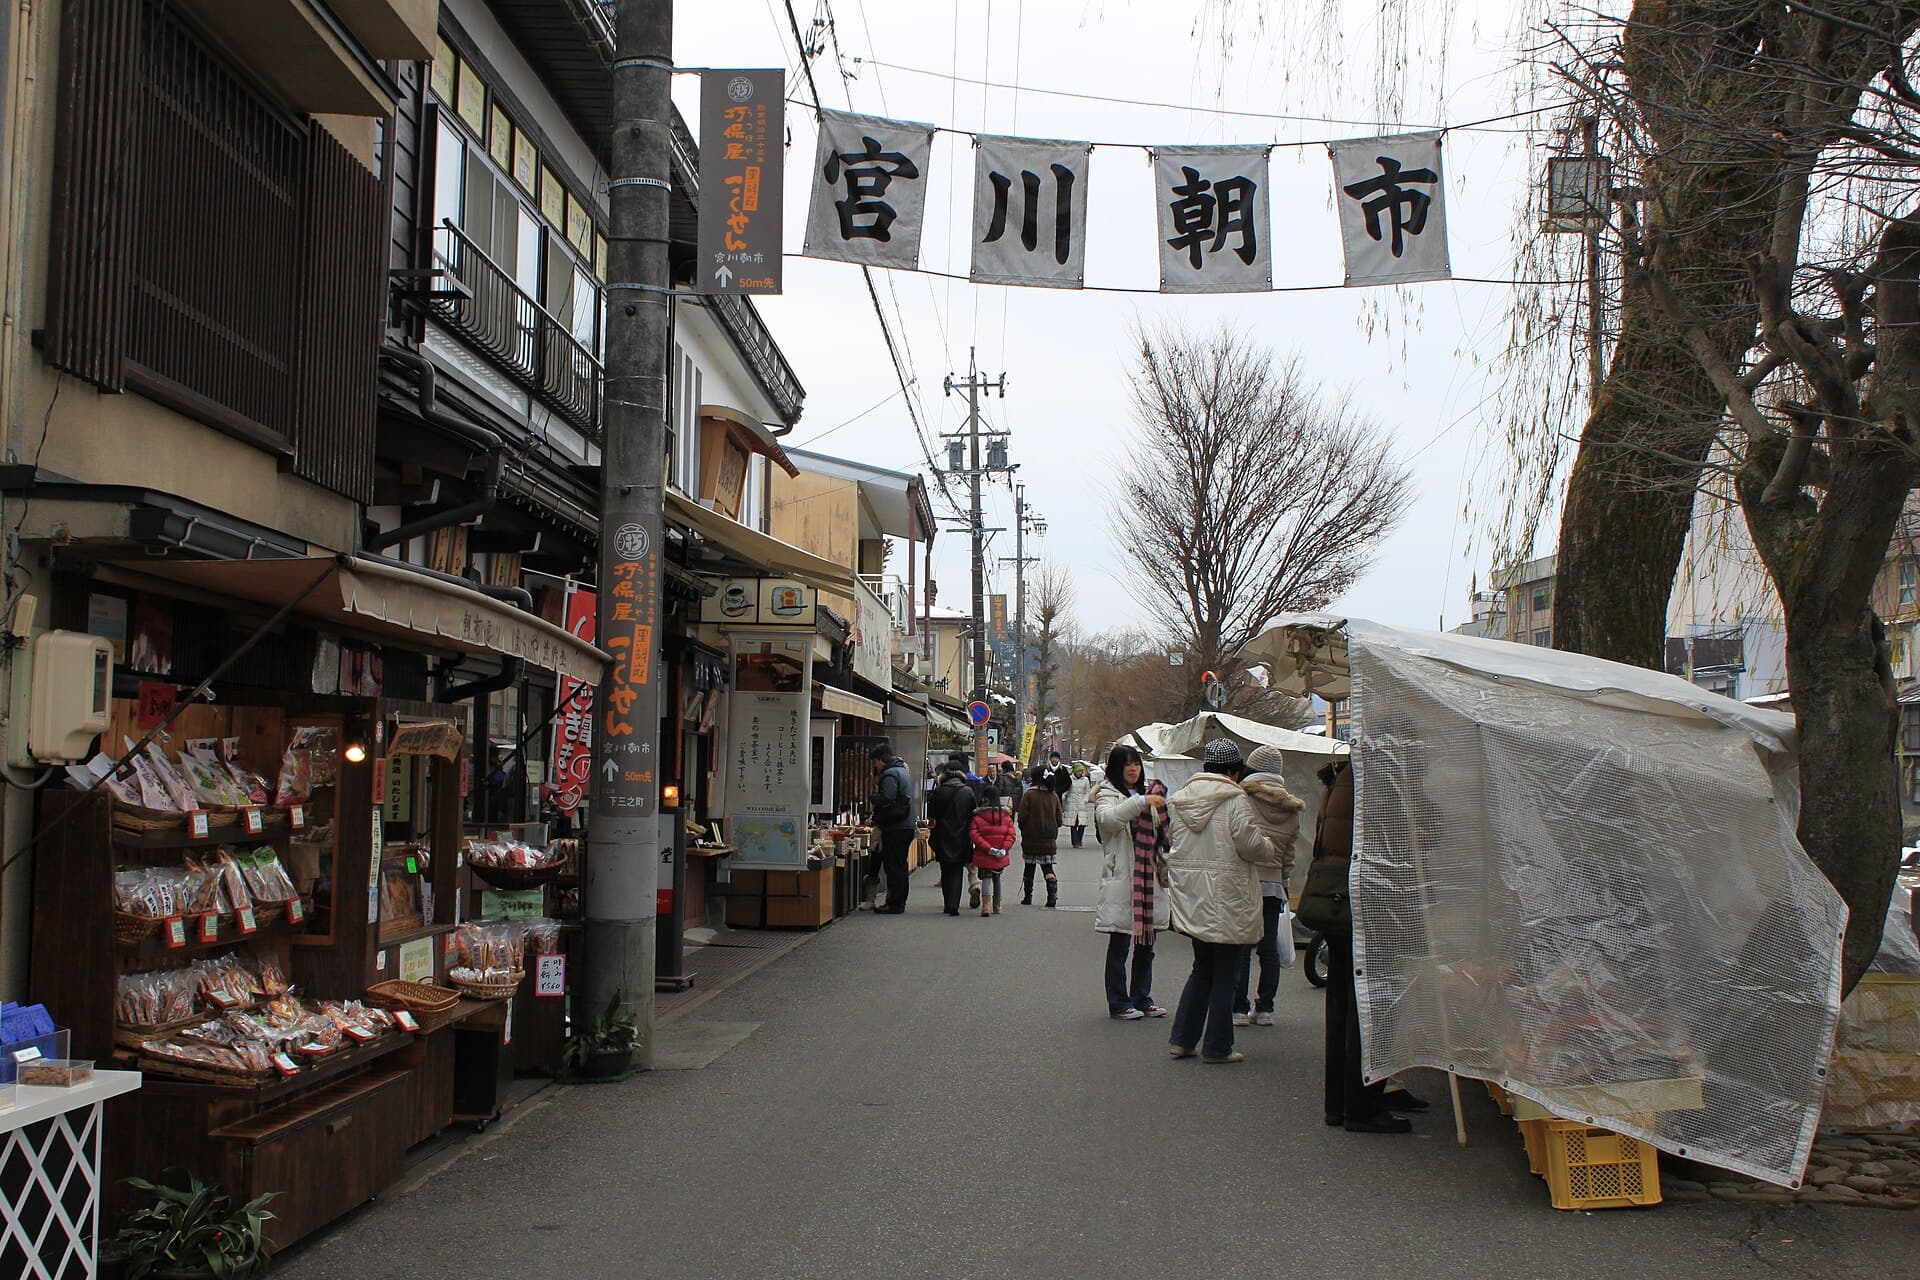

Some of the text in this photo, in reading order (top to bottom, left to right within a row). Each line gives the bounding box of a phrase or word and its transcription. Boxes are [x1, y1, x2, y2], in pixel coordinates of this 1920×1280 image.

[724, 106, 748, 160] 打保屋
[725, 176, 748, 251] こくせん
[739, 277, 776, 289] 50m先
[613, 563, 638, 621] 打保屋
[606, 636, 639, 738] こくせん
[624, 770, 652, 783] 50m先
[608, 796, 645, 808] 下三之町
[660, 845, 673, 864] 堂
[541, 981, 561, 992] ¥560
